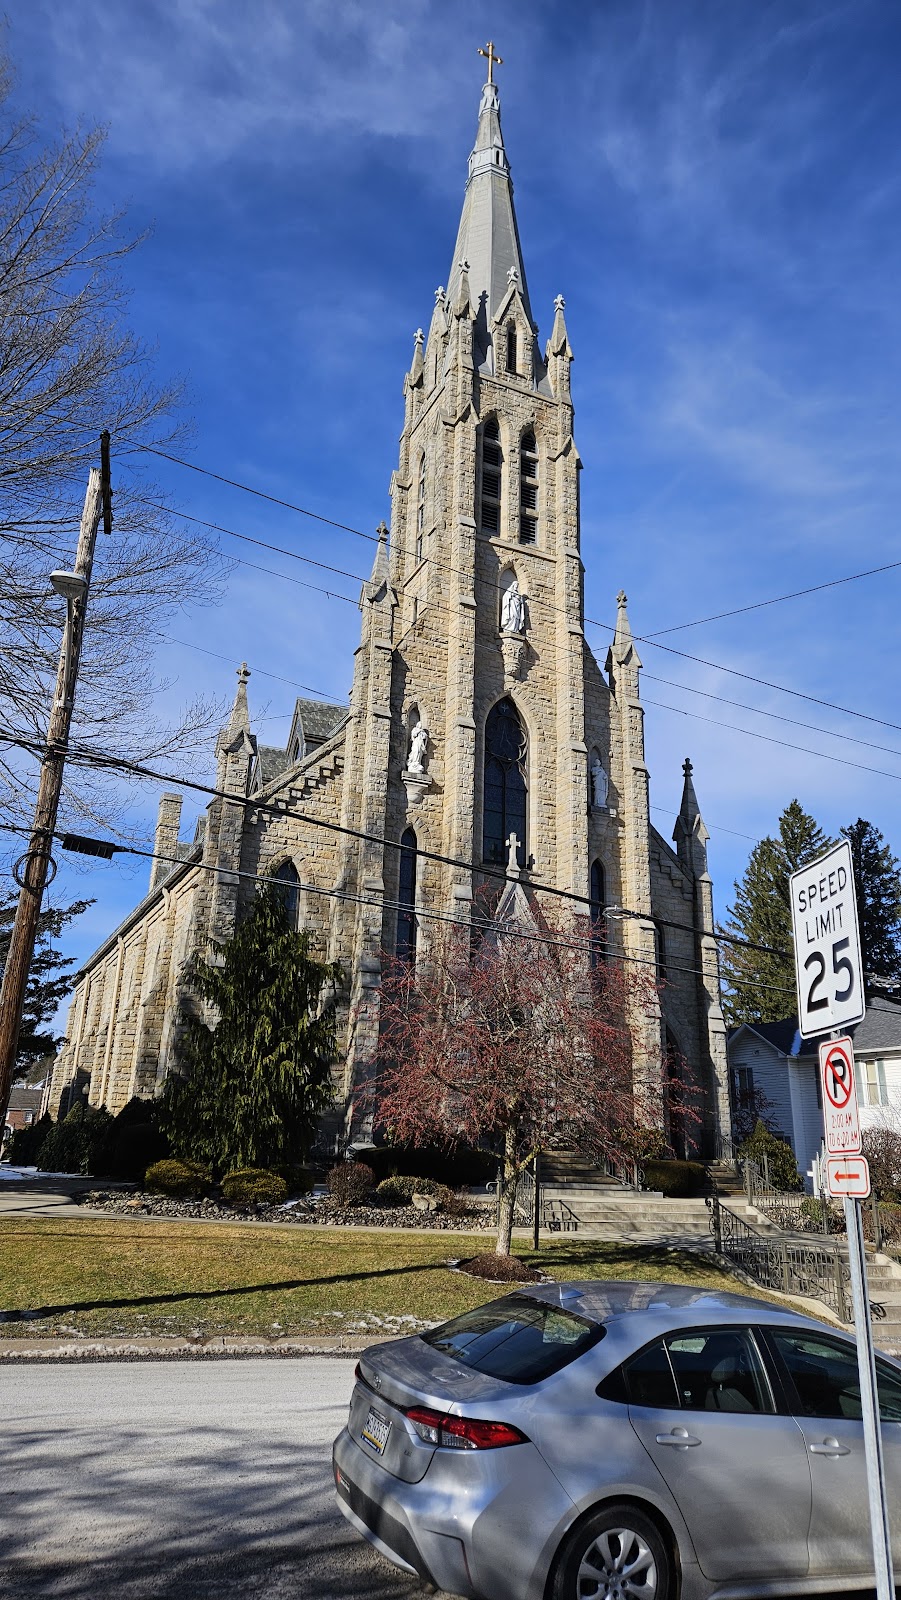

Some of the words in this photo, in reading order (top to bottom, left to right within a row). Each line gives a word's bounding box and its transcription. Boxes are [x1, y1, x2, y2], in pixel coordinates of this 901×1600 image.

[798, 866, 847, 913] SPEED
[805, 903, 844, 944] LIMIT
[804, 936, 855, 1014] 25
[829, 1133, 835, 1146] TO
[837, 1132, 849, 1146] 6:00
[851, 1130, 858, 1145] AM
[832, 1114, 844, 1128] 2:00
[846, 1113, 852, 1126] AM
